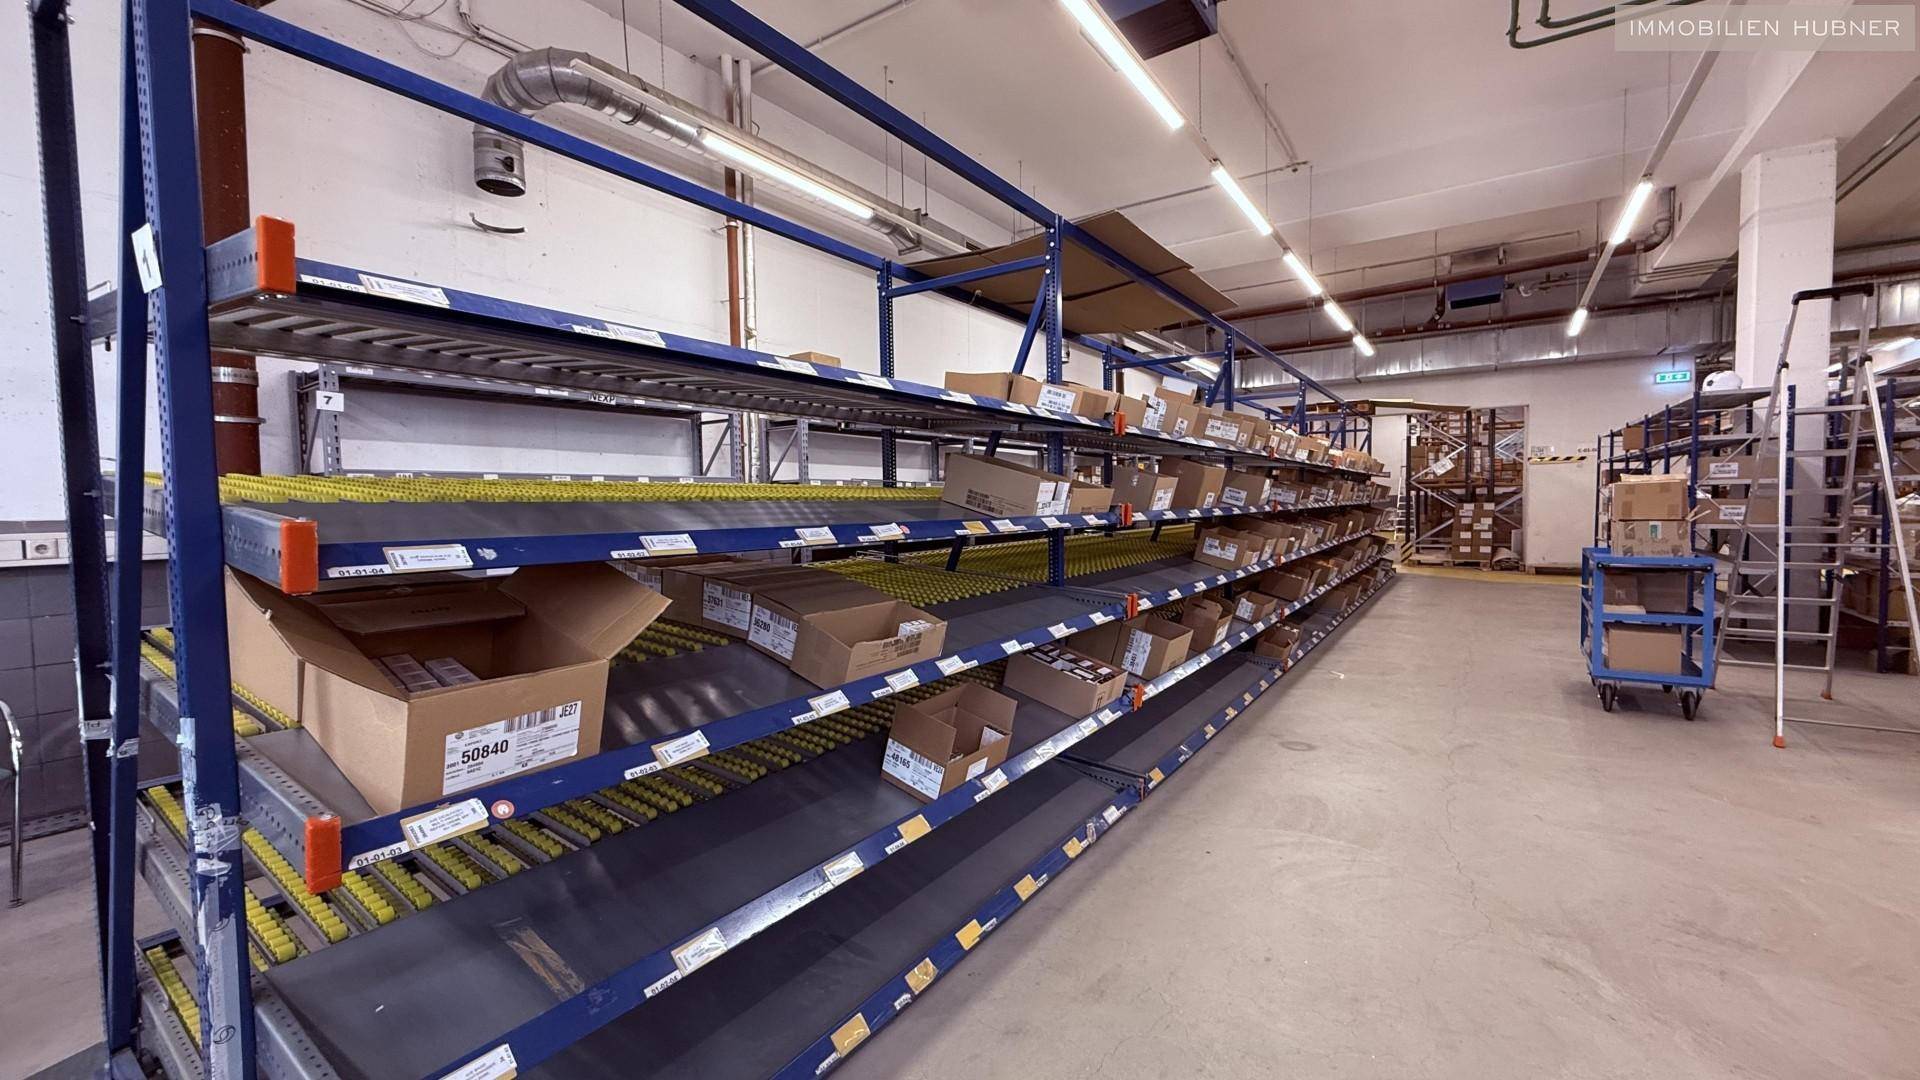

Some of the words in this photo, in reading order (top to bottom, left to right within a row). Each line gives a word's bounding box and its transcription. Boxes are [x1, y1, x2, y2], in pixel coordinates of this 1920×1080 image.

[323, 395, 333, 404] 7
[338, 567, 385, 577] 01-01-04
[559, 703, 578, 718] JE27
[461, 739, 509, 765] 50840
[356, 847, 403, 867] 01-01-03
